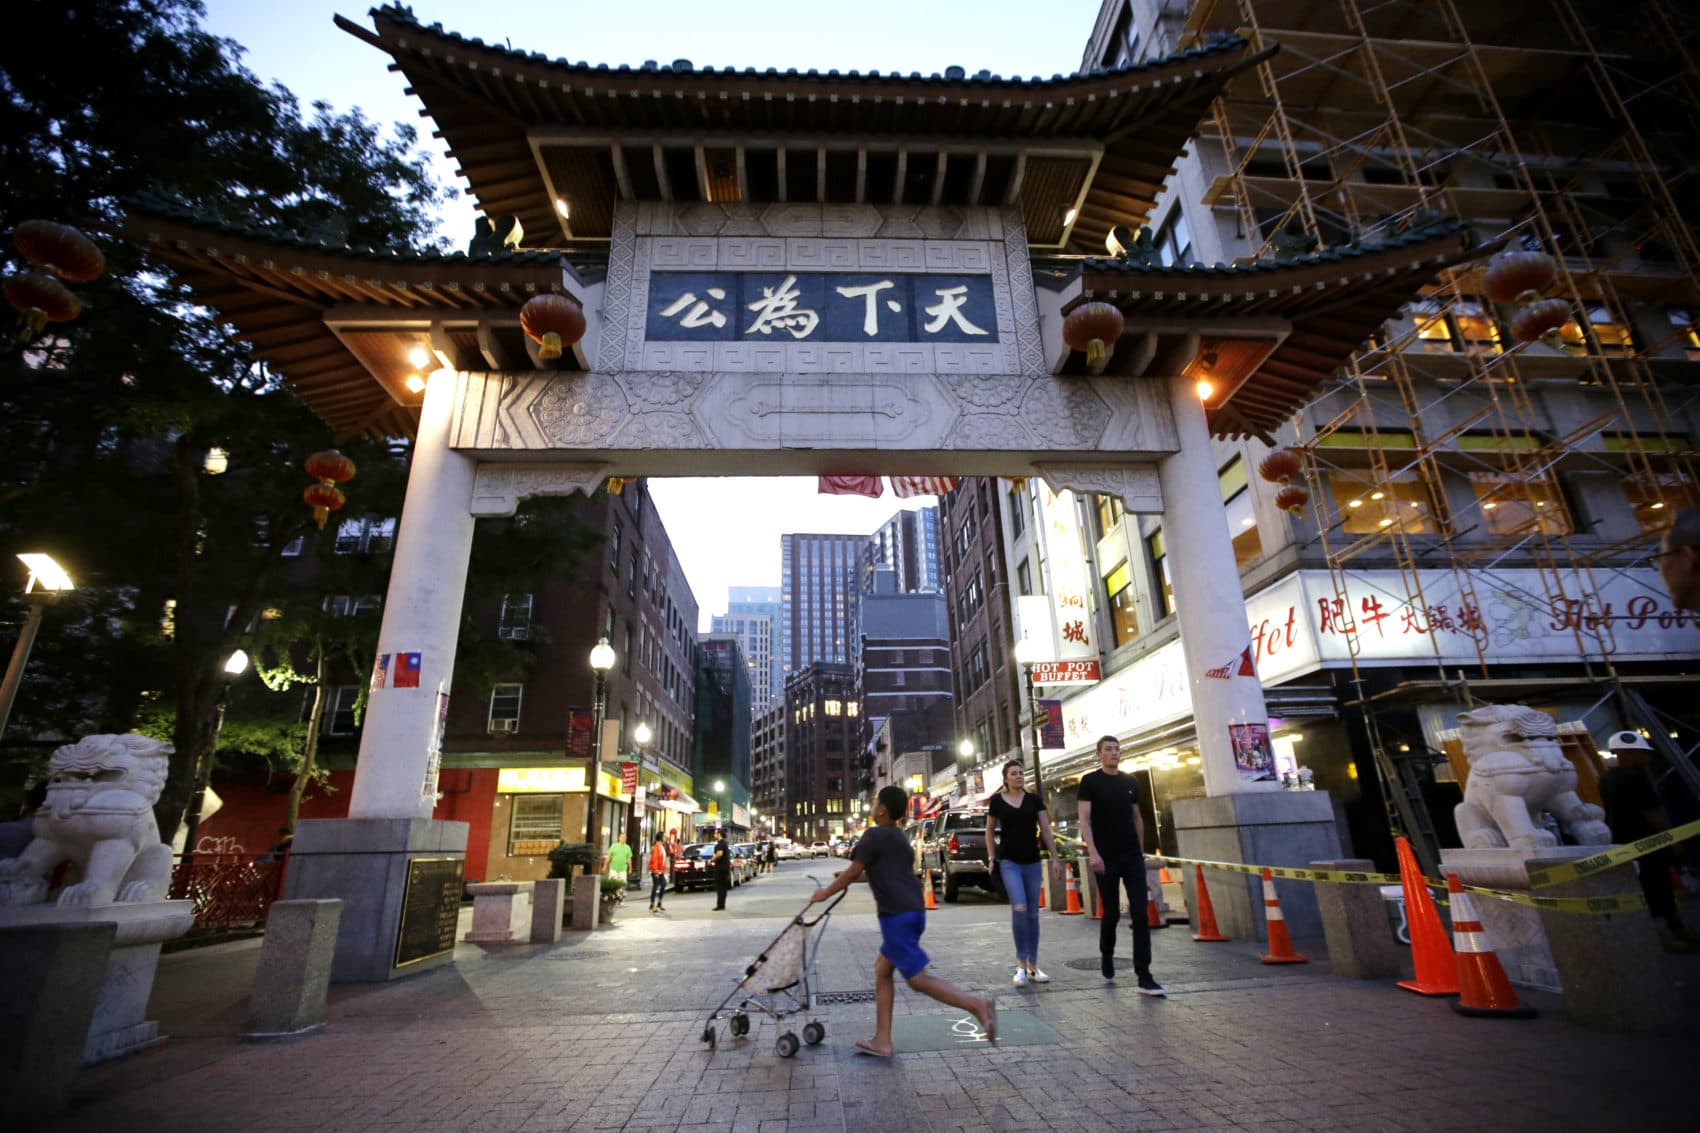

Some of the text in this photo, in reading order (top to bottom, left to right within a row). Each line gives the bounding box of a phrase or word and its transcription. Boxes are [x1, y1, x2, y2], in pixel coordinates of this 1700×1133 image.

[1626, 596, 1688, 630] Pot
[1032, 662, 1094, 673] HOT POT
[1040, 672, 1088, 681] BUFFET
